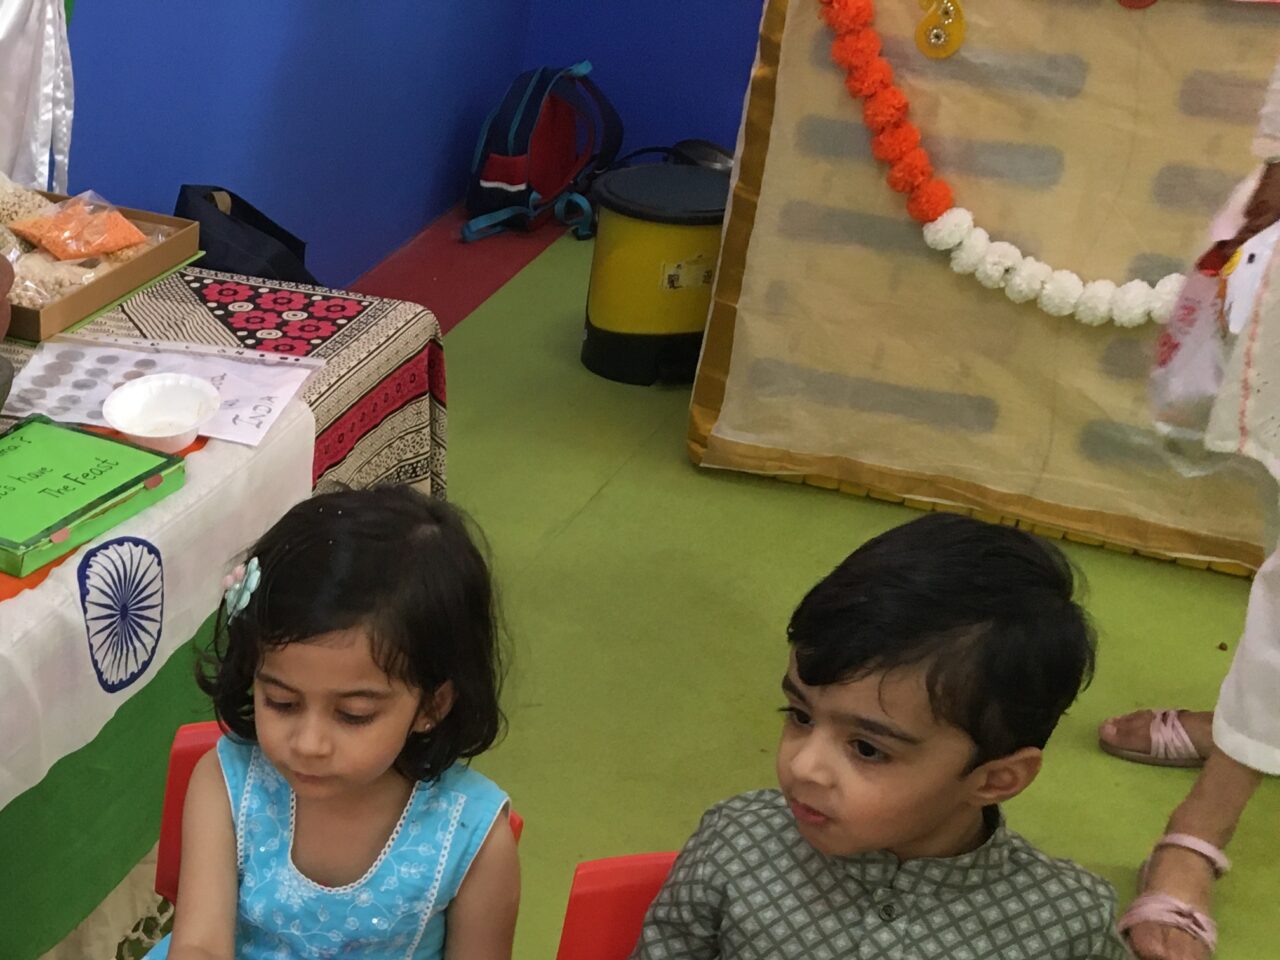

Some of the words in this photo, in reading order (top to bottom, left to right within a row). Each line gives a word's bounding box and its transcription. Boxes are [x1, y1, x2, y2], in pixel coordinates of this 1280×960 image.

[7, 464, 55, 485] have
[36, 482, 77, 500] The
[61, 456, 120, 486] Feast
